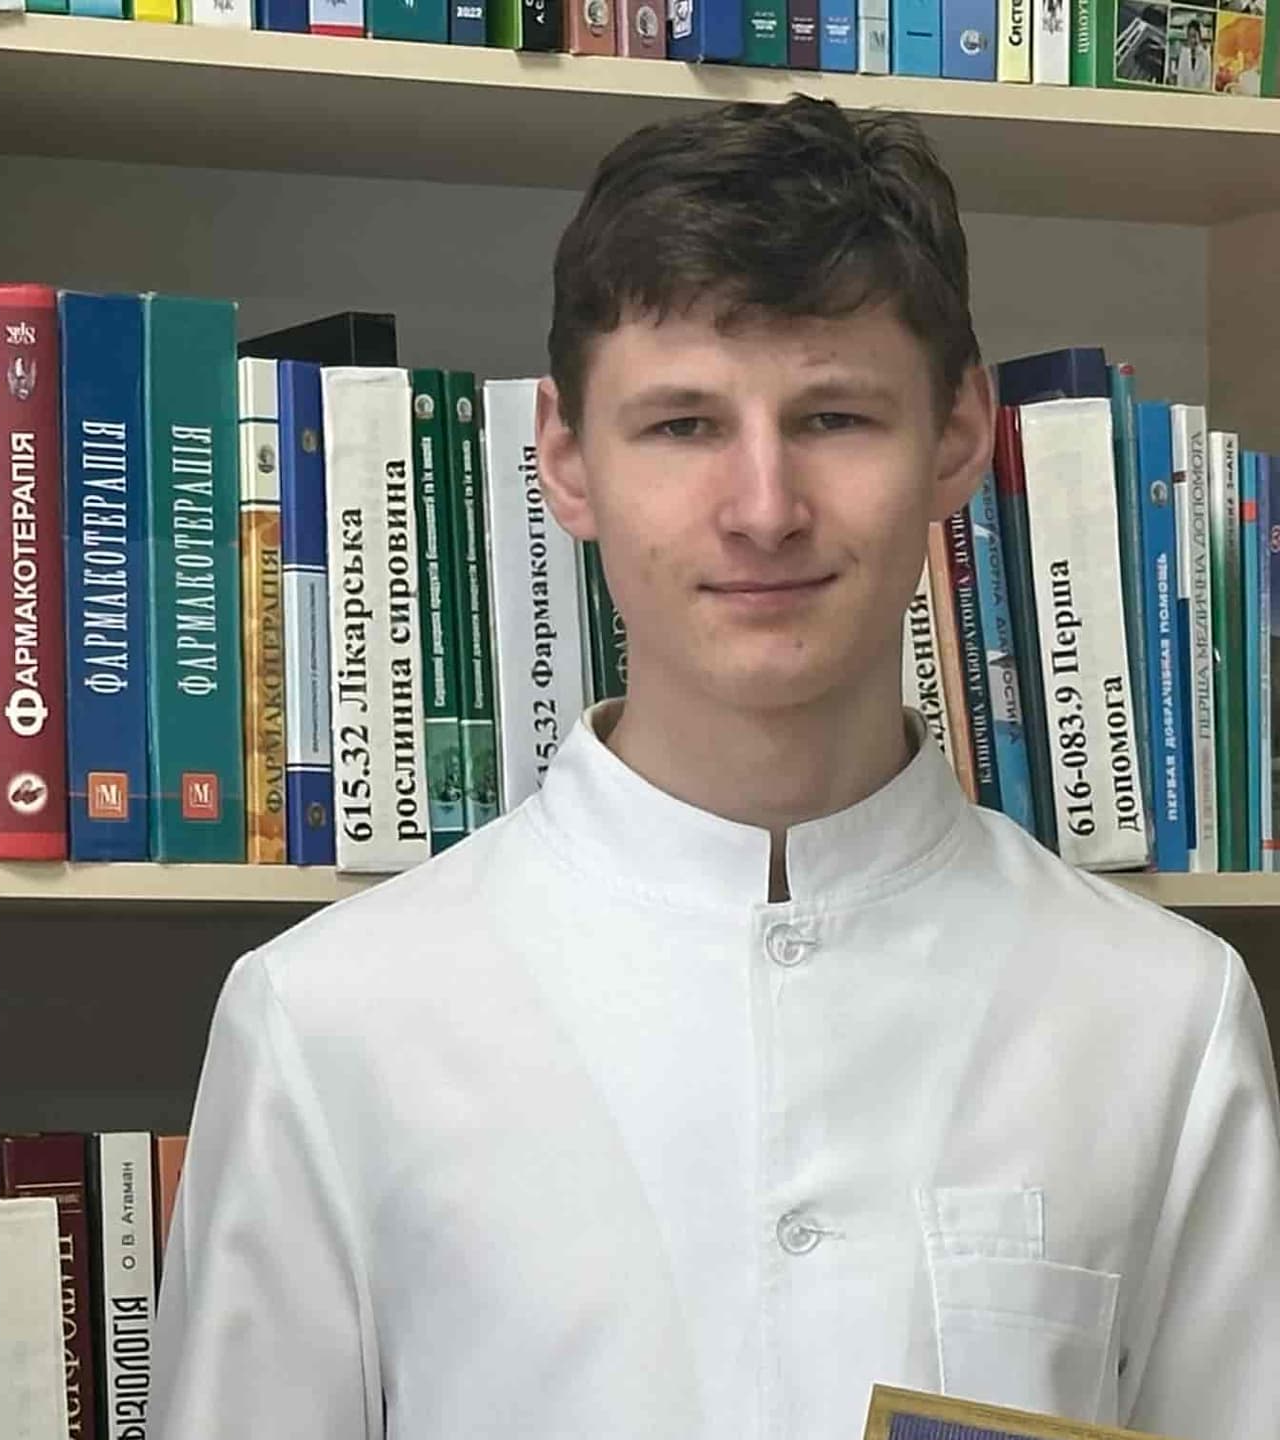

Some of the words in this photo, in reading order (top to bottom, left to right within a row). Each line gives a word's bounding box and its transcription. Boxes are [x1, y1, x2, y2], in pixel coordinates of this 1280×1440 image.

[83, 421, 129, 695] ФАРМАКОТЕРАПІЯ
[172, 425, 218, 697] ФАРМАКОТЕРАПІЯ
[384, 459, 417, 644] сировина
[518, 446, 557, 689] Фармакогнозія
[1191, 431, 1205, 544] ДОПОМОГА
[5, 431, 49, 737] ФАРМАКОТЕРАПІЯ
[338, 508, 372, 712] Лікарська
[1049, 559, 1083, 676] Перша
[339, 725, 372, 843] 615.32
[390, 658, 427, 842] рослинна
[1059, 686, 1096, 837] 616-083.9
[1103, 675, 1141, 834] допомога
